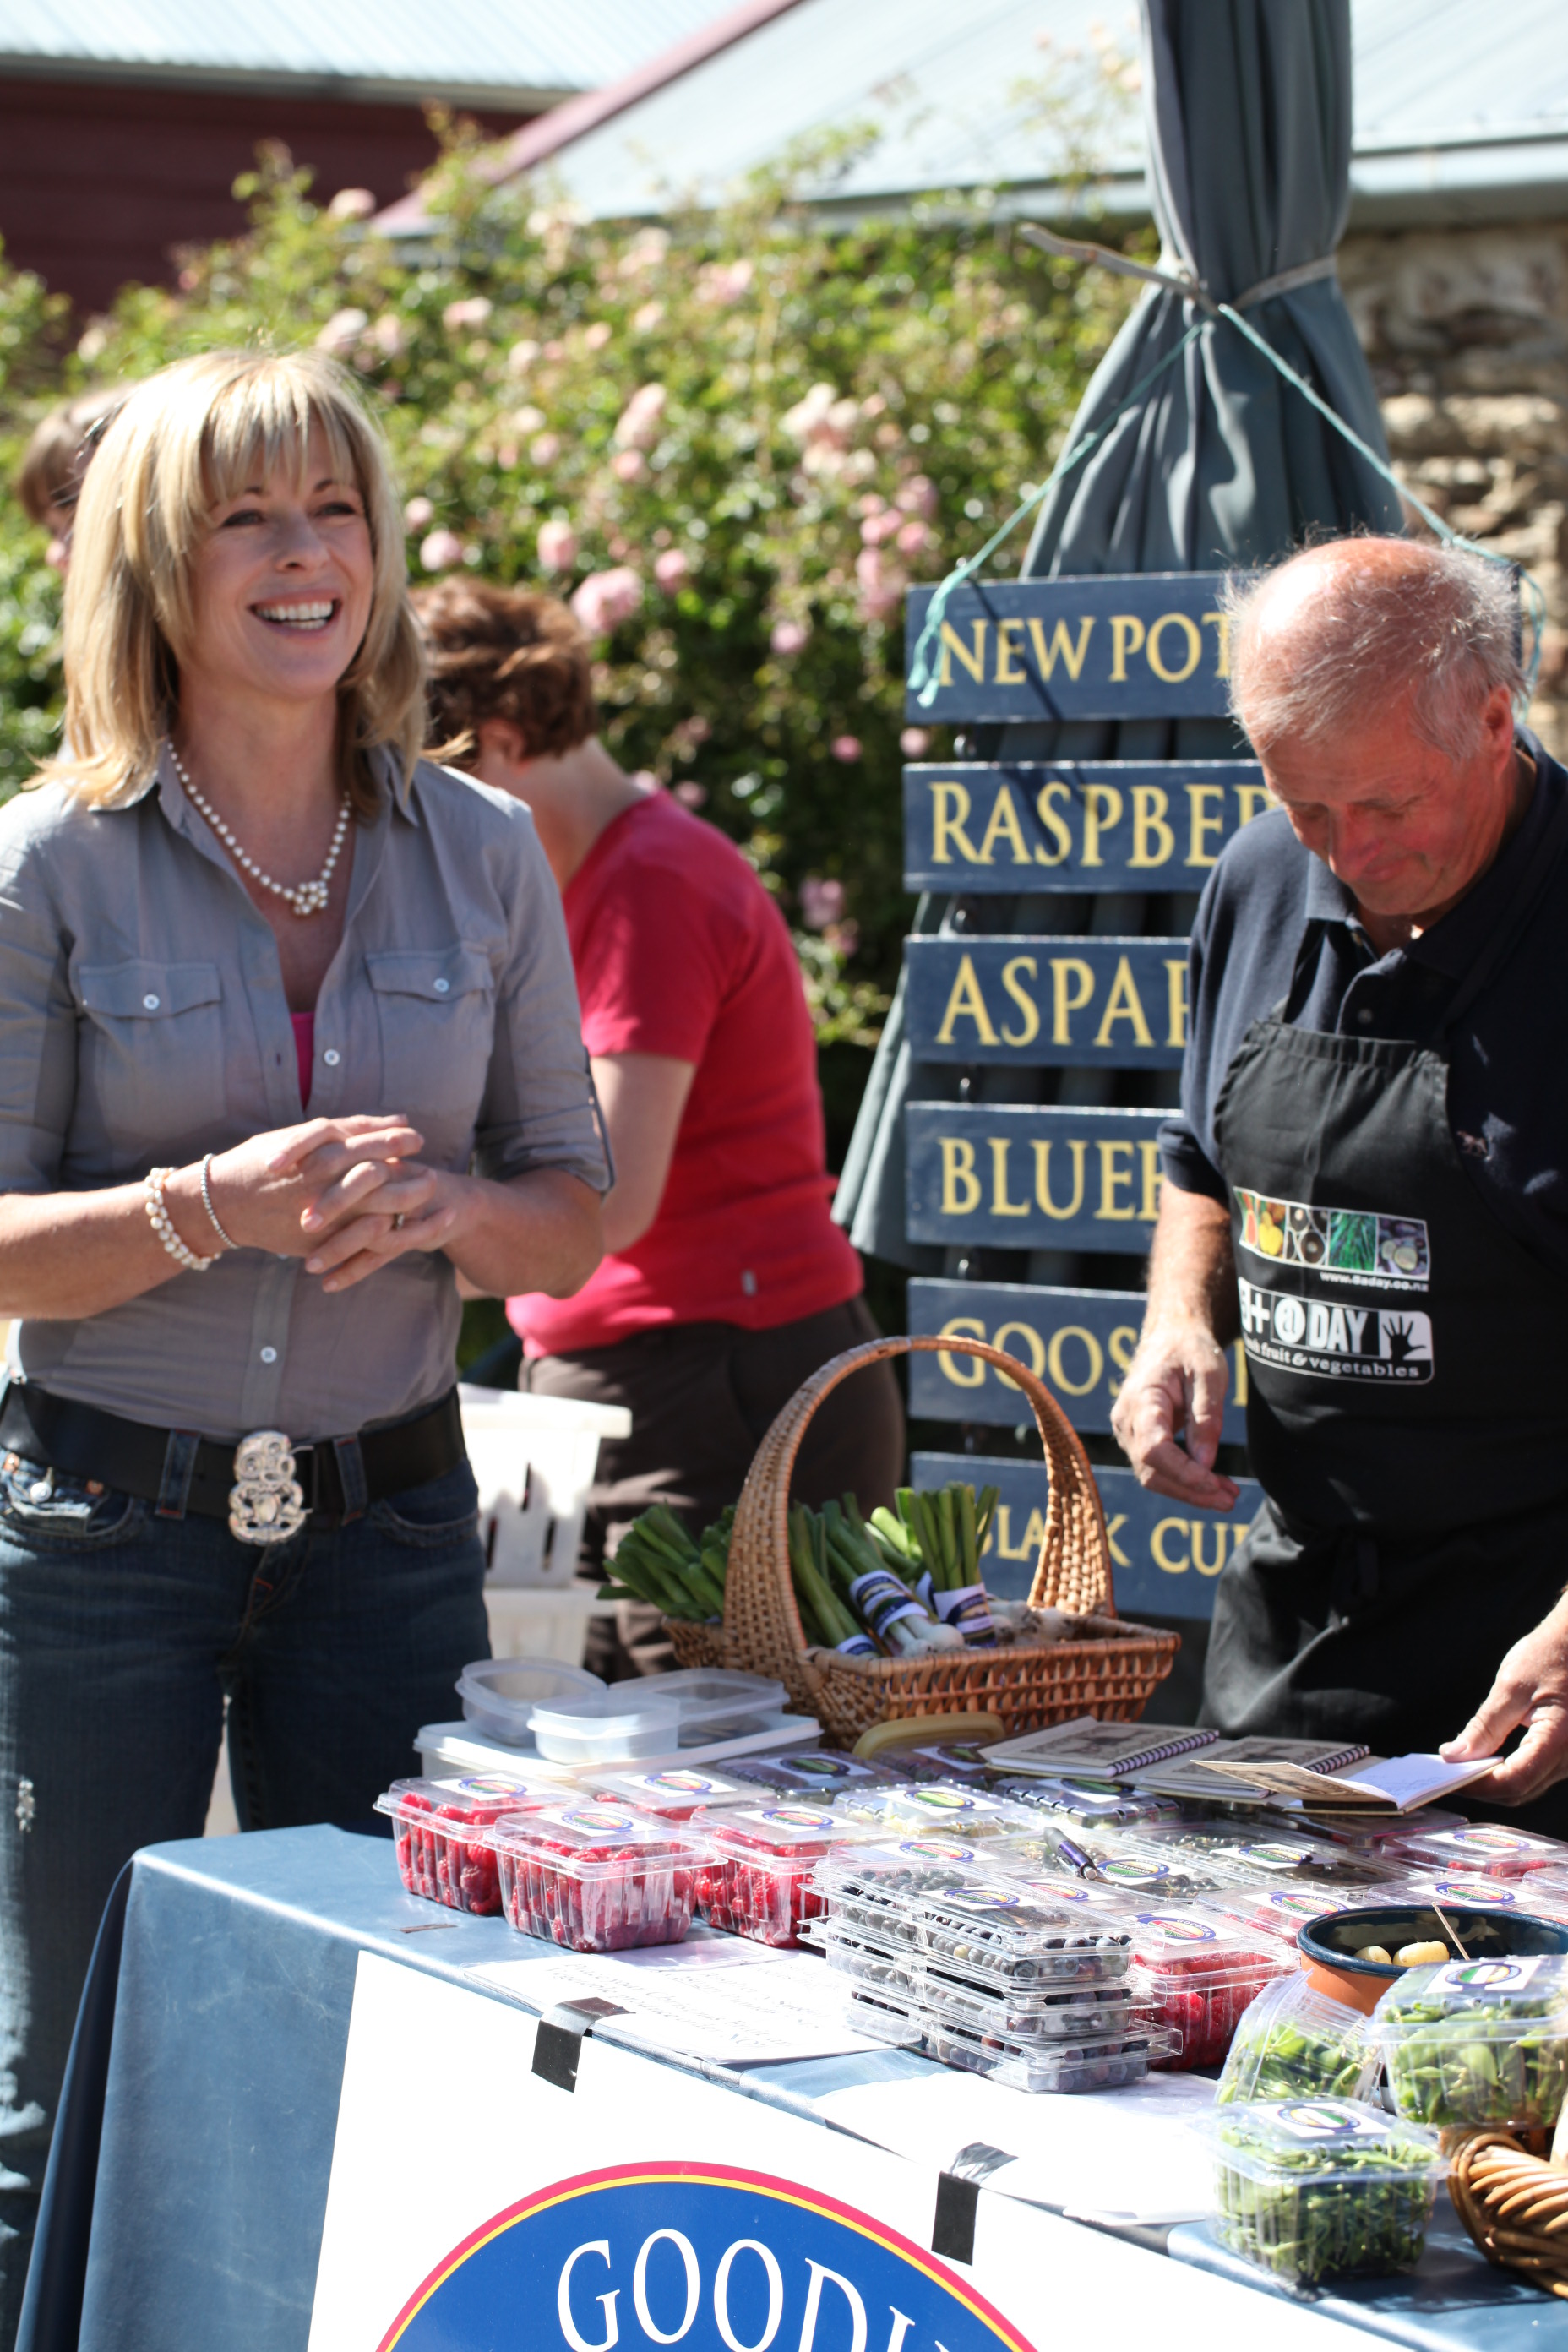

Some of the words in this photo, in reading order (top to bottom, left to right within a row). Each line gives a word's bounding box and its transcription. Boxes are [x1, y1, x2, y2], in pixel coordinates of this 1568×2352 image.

[938, 616, 1096, 686] NEW
[1309, 1304, 1369, 1355] DAY
[1260, 1342, 1291, 1364] fruit
[1291, 1352, 1308, 1367] &
[1309, 1355, 1420, 1378] vegetables
[640, 1990, 732, 2021] Christmas
